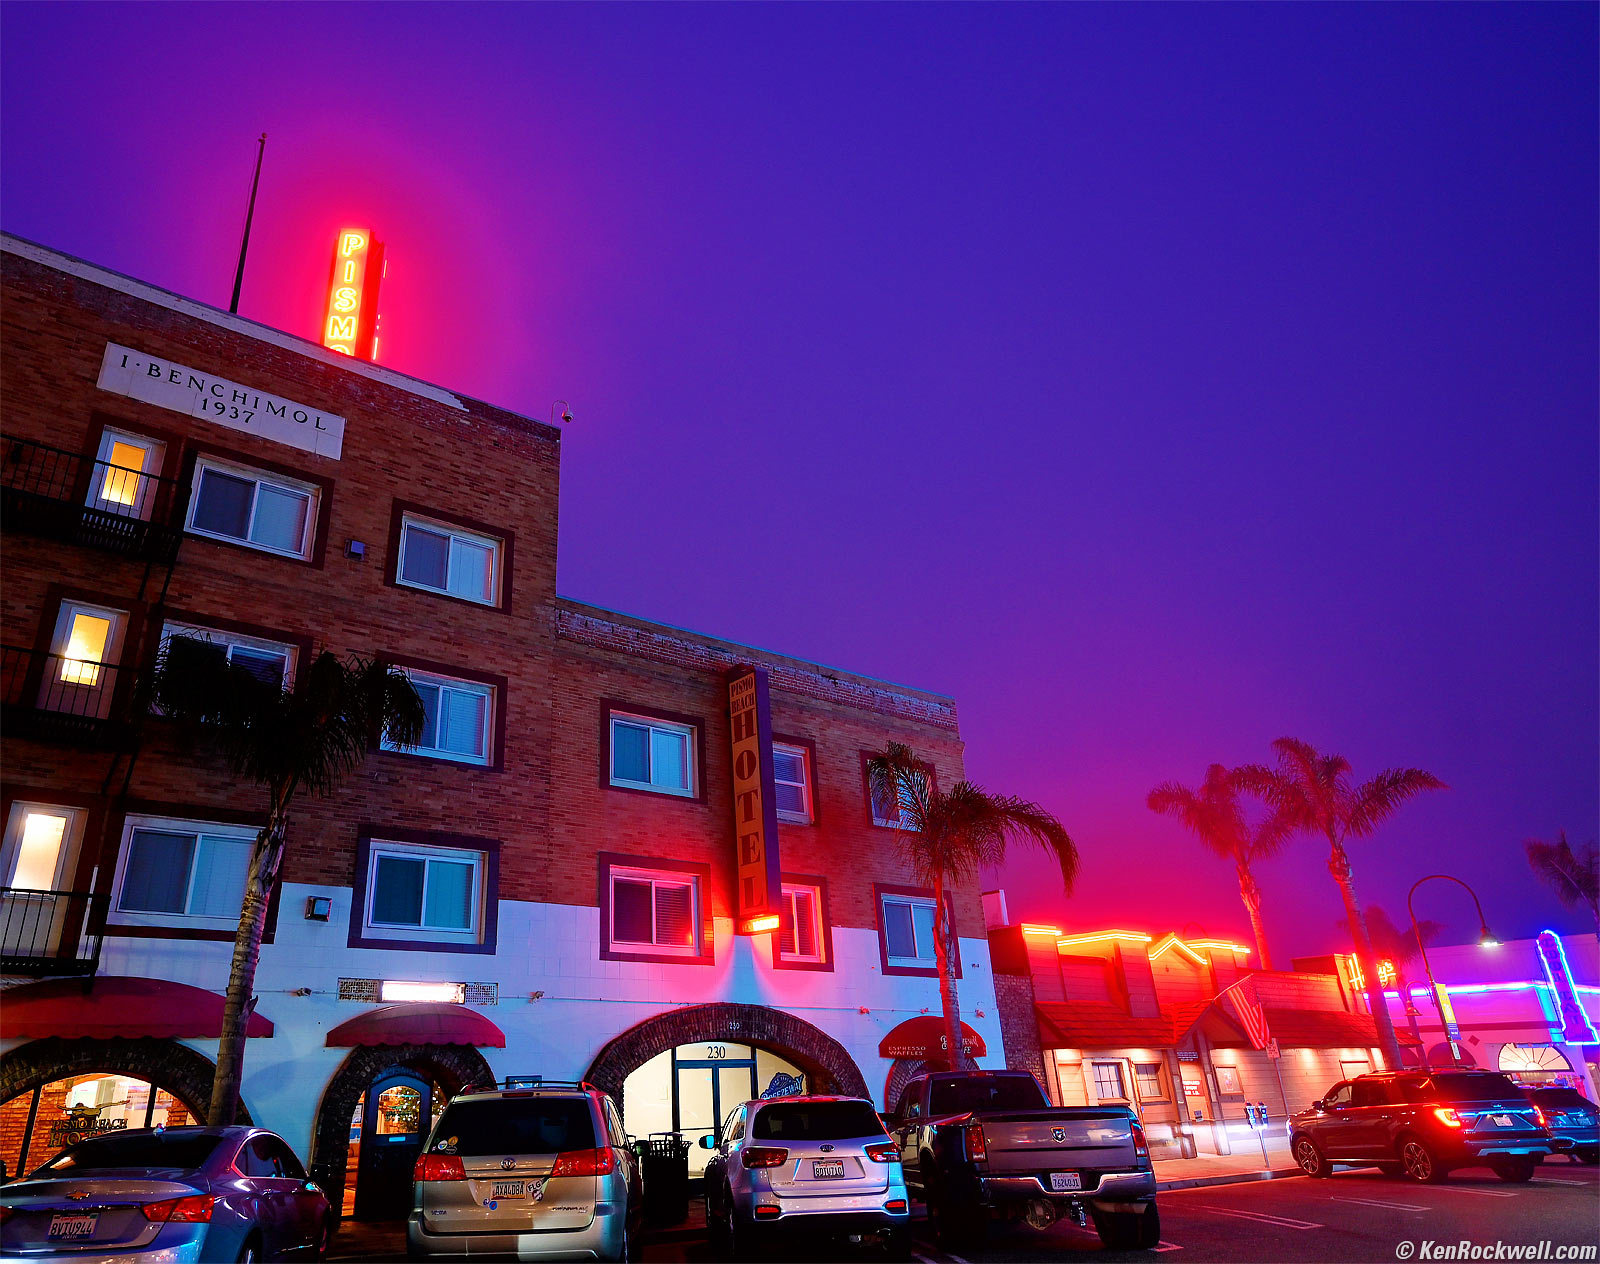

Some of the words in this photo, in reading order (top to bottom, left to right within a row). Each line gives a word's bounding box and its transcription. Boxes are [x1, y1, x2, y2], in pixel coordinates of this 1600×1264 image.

[147, 362, 327, 431] BENCHIMOL
[202, 398, 255, 424] 1937
[730, 675, 754, 698] PISMO
[731, 692, 755, 714] BEACH
[732, 707, 764, 909] HOTEL
[729, 1021, 741, 1031] 230
[707, 1045, 726, 1059] 230
[495, 1184, 524, 1196] AXA4D8A
[527, 1181, 542, 1192] FLG
[50, 1221, 93, 1236] 8VTU944
